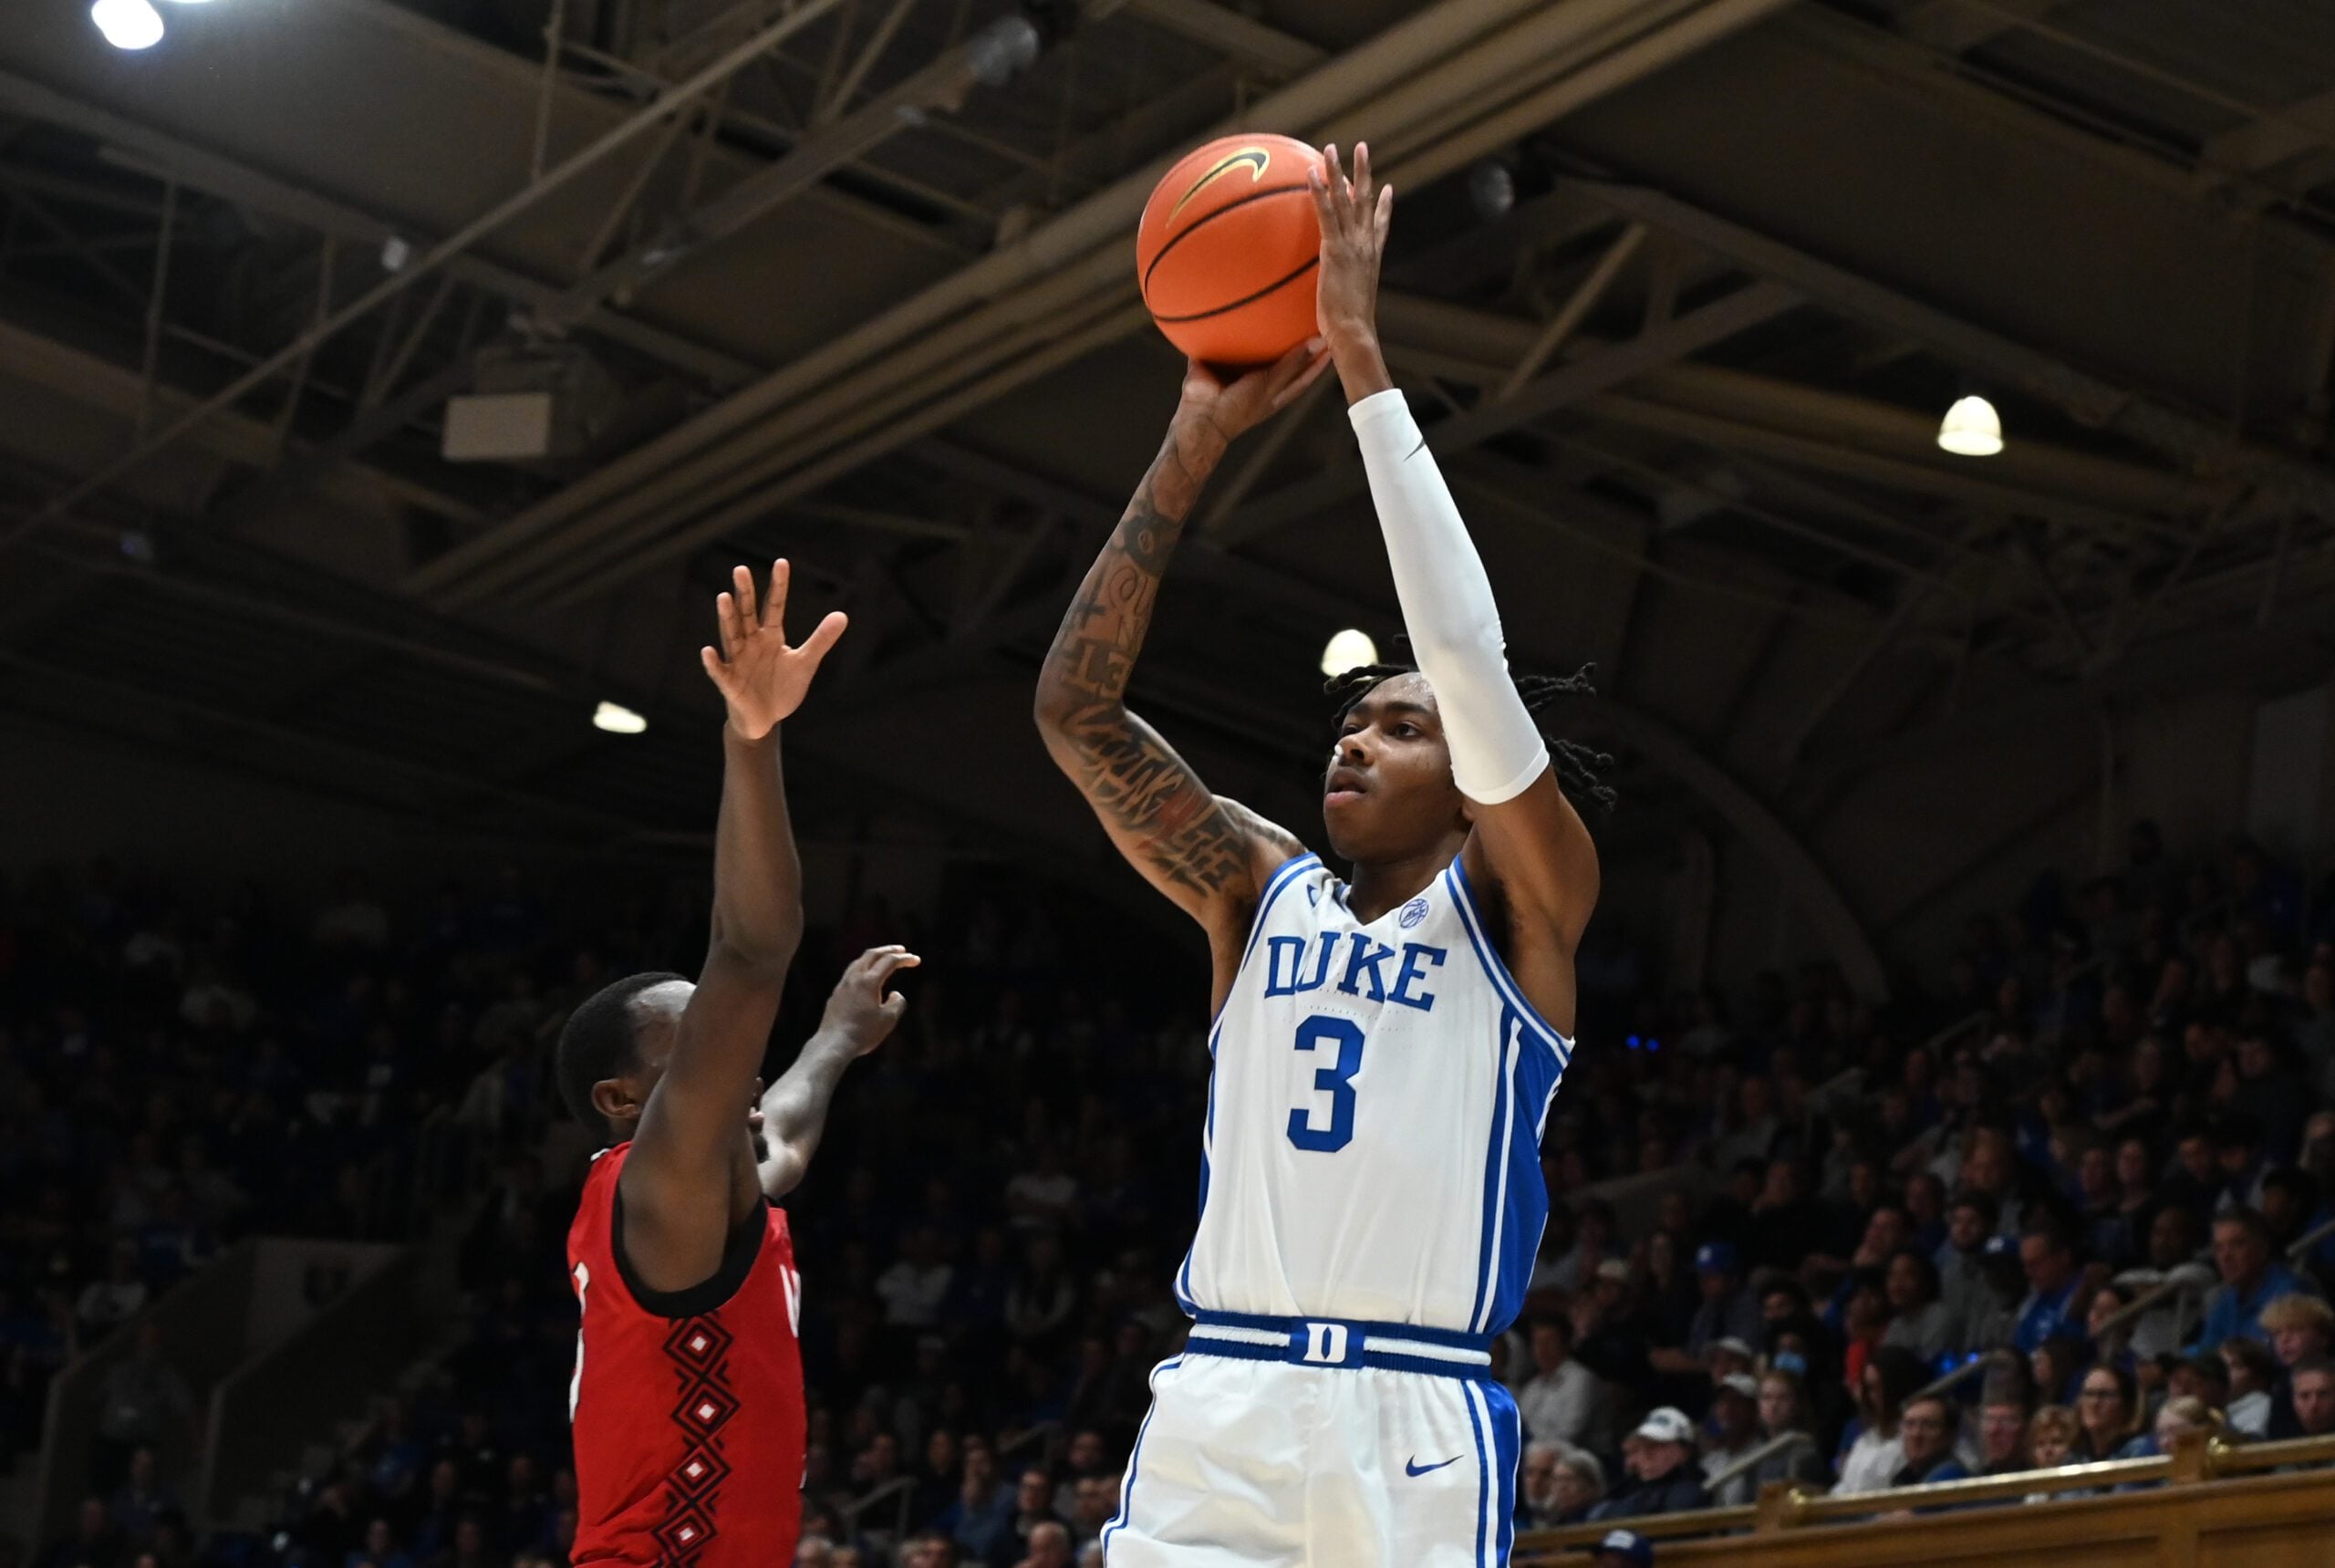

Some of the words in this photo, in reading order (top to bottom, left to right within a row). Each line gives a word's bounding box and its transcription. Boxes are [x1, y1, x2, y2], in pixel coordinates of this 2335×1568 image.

[1264, 930, 1448, 1012] DUKE
[1286, 1014, 1365, 1153] 3
[1302, 1322, 1348, 1364] D
